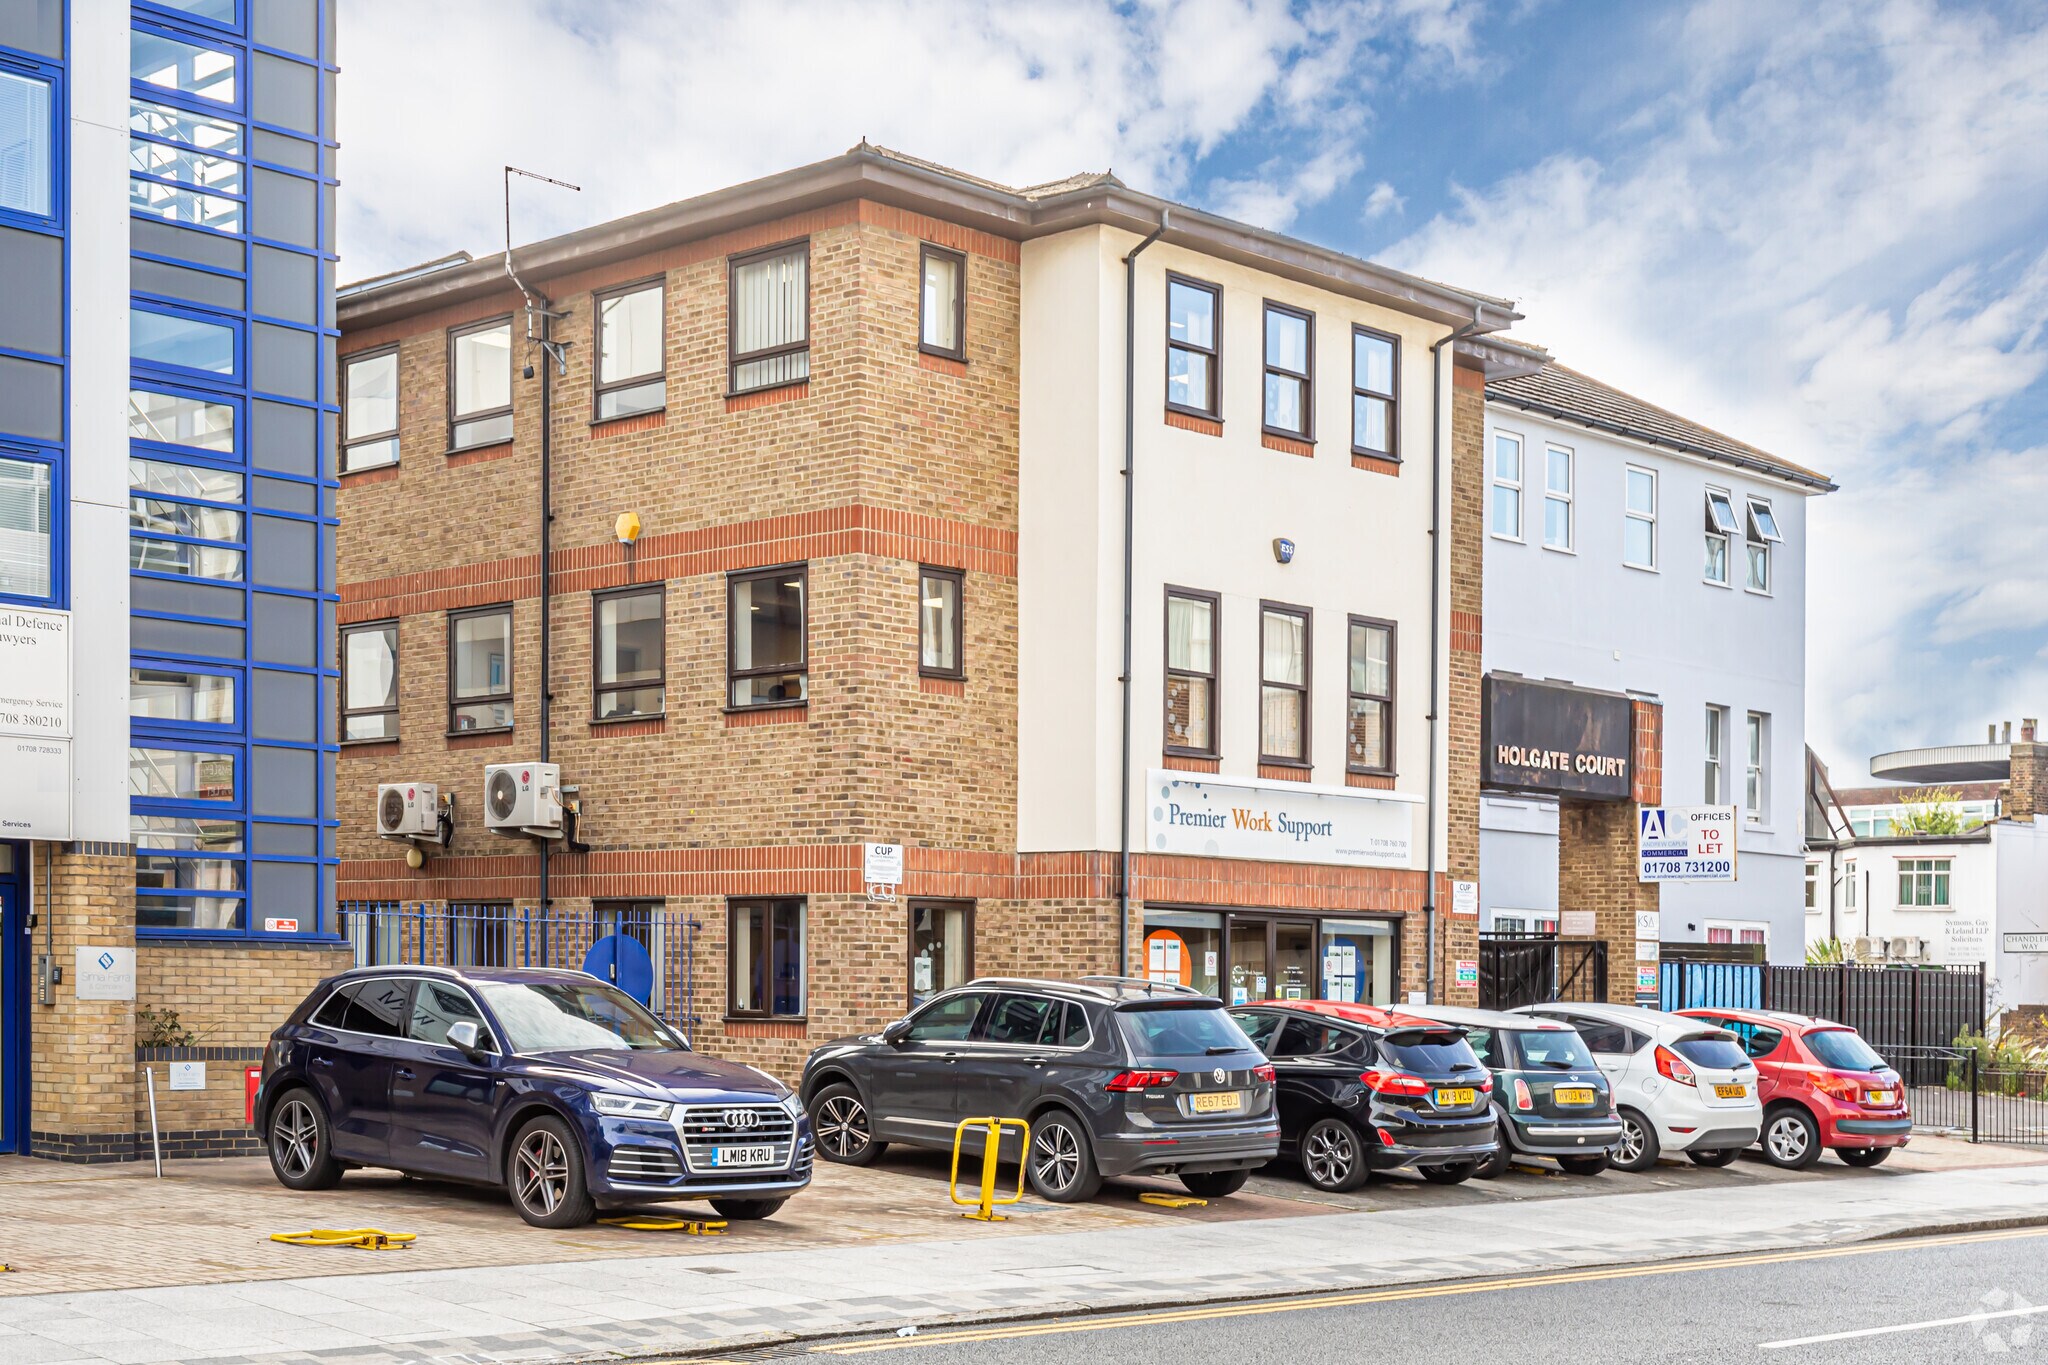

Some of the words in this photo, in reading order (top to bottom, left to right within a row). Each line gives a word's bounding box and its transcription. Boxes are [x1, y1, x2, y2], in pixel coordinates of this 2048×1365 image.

[16, 615, 63, 631] Defence
[36, 699, 63, 708] Service
[22, 714, 62, 728] 380210
[17, 744, 37, 753] 01708
[1497, 744, 1570, 772] HOLGATE
[1575, 753, 1626, 777] COURT
[1690, 812, 1731, 822] OFFICES
[2, 819, 32, 829] Services
[1168, 803, 1227, 829] Premier
[1231, 808, 1273, 832] Work
[1277, 812, 1333, 842] Support
[1700, 829, 1720, 840] TO
[874, 845, 893, 856] CUP
[1642, 849, 1688, 858] COMMERCIAL
[1697, 843, 1724, 854] LET
[1644, 861, 1681, 874] 01708
[1684, 861, 1731, 873] 731200
[1459, 883, 1471, 891] CUP
[1945, 919, 1973, 928] Symons,
[1975, 919, 1988, 927] Gay
[1945, 927, 1951, 935] &
[1952, 926, 1974, 935] Leland
[1975, 927, 1989, 935] LLP
[1951, 936, 1983, 944] Solicitors
[1717, 1086, 1732, 1096] EF64
[1195, 1096, 1219, 1108] RE67
[1221, 1095, 1239, 1106] EDJ
[722, 1149, 747, 1163] LM18
[750, 1148, 771, 1161] KRU
